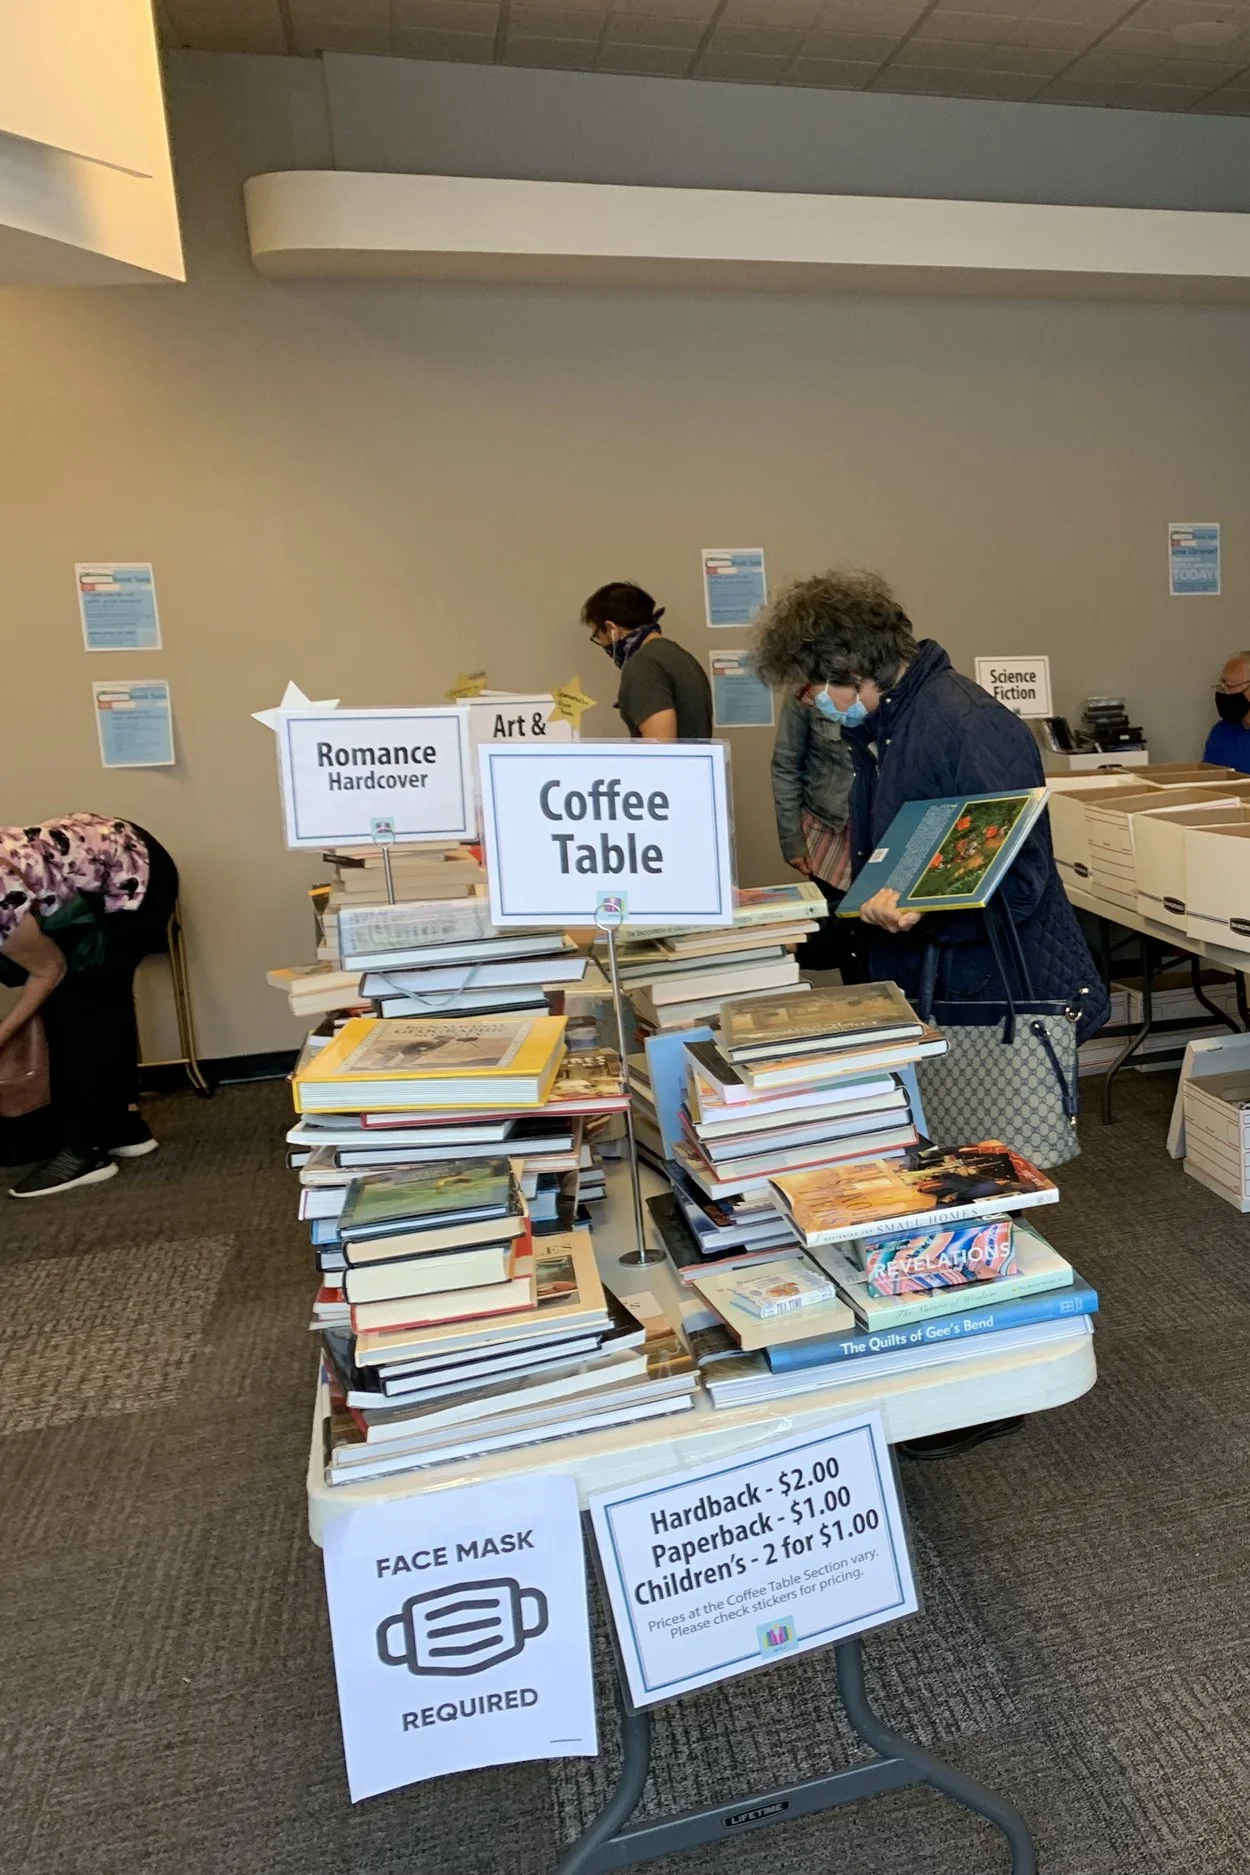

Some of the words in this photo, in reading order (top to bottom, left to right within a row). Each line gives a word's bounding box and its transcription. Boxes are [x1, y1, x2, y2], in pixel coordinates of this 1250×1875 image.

[990, 669, 1036, 684] Science
[993, 686, 1036, 700] Fiction
[493, 714, 526, 738] Art
[531, 712, 546, 736] &
[317, 741, 437, 767] Romance
[328, 771, 429, 791] Hardcover
[539, 778, 670, 822] Coffee
[551, 833, 664, 875] Table
[876, 1219, 923, 1233] SMALL
[929, 1208, 979, 1225] HOMES
[874, 1241, 1011, 1278] REVELATIONS
[840, 1341, 866, 1355] The
[869, 1334, 908, 1352] Quilts
[910, 1329, 923, 1344] of
[926, 1324, 961, 1339] Gee's
[964, 1315, 994, 1332] Bend
[650, 1482, 763, 1535] Hardback
[778, 1457, 840, 1496] $2.00
[651, 1511, 774, 1568] Paperback
[790, 1485, 851, 1525] $1.00
[376, 1547, 448, 1578] FACE
[456, 1530, 535, 1562] MASK
[634, 1553, 747, 1606] Children's
[763, 1543, 778, 1566] 2
[781, 1534, 815, 1560] for
[819, 1508, 880, 1548] $1.00
[648, 1614, 686, 1632] Prices
[688, 1608, 701, 1620] at
[703, 1600, 725, 1613] the
[727, 1585, 767, 1606] Coffee
[768, 1576, 801, 1592] Table
[803, 1559, 848, 1580] Section
[850, 1549, 880, 1565] vary.
[670, 1621, 710, 1640] Please
[713, 1607, 750, 1625] check
[752, 1591, 798, 1612] stickers
[800, 1583, 817, 1596] for
[819, 1568, 864, 1592] pricing.
[402, 1688, 539, 1732] REQUIRED
[731, 1803, 783, 1825] LIFETIME
